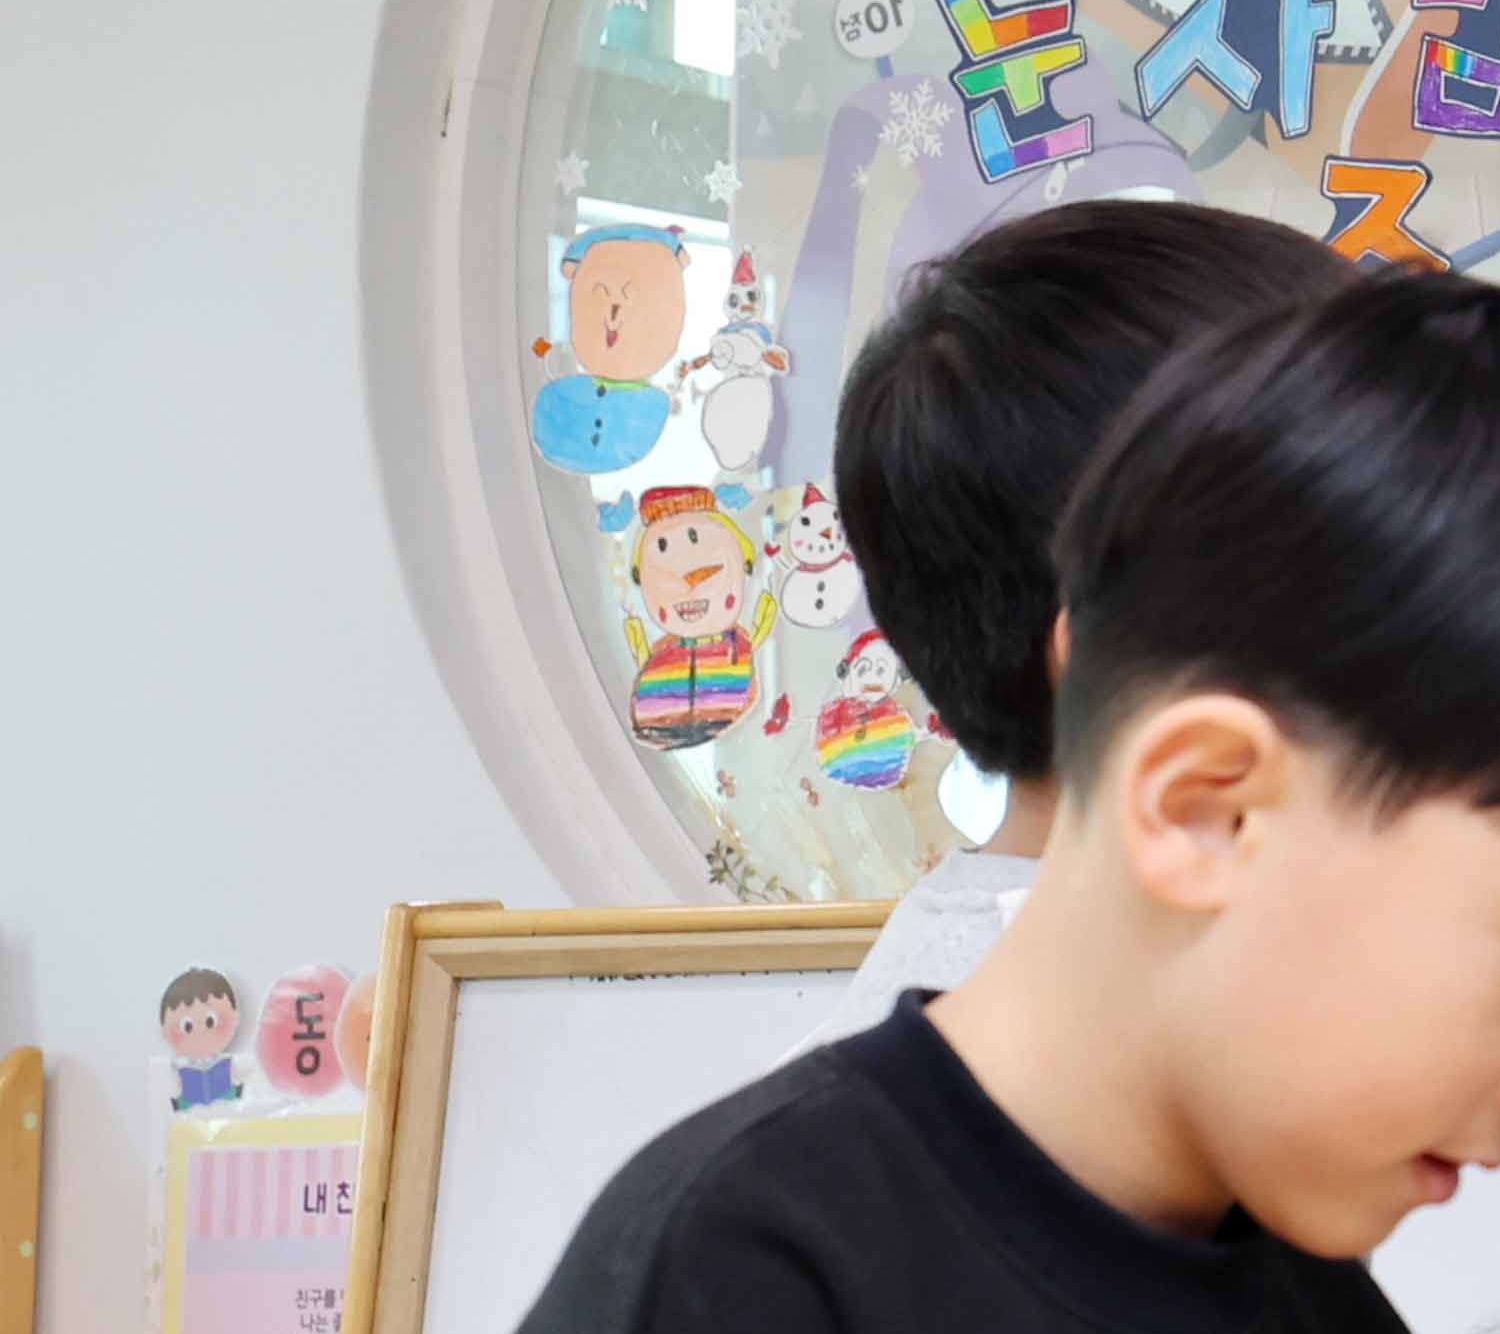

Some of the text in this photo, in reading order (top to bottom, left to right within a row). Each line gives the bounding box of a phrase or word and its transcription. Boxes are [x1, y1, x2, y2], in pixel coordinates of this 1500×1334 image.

[291, 992, 327, 1077] 동
[303, 1180, 353, 1215] 내 친
[295, 1288, 336, 1310] 친구를
[299, 1313, 330, 1333] 나는
